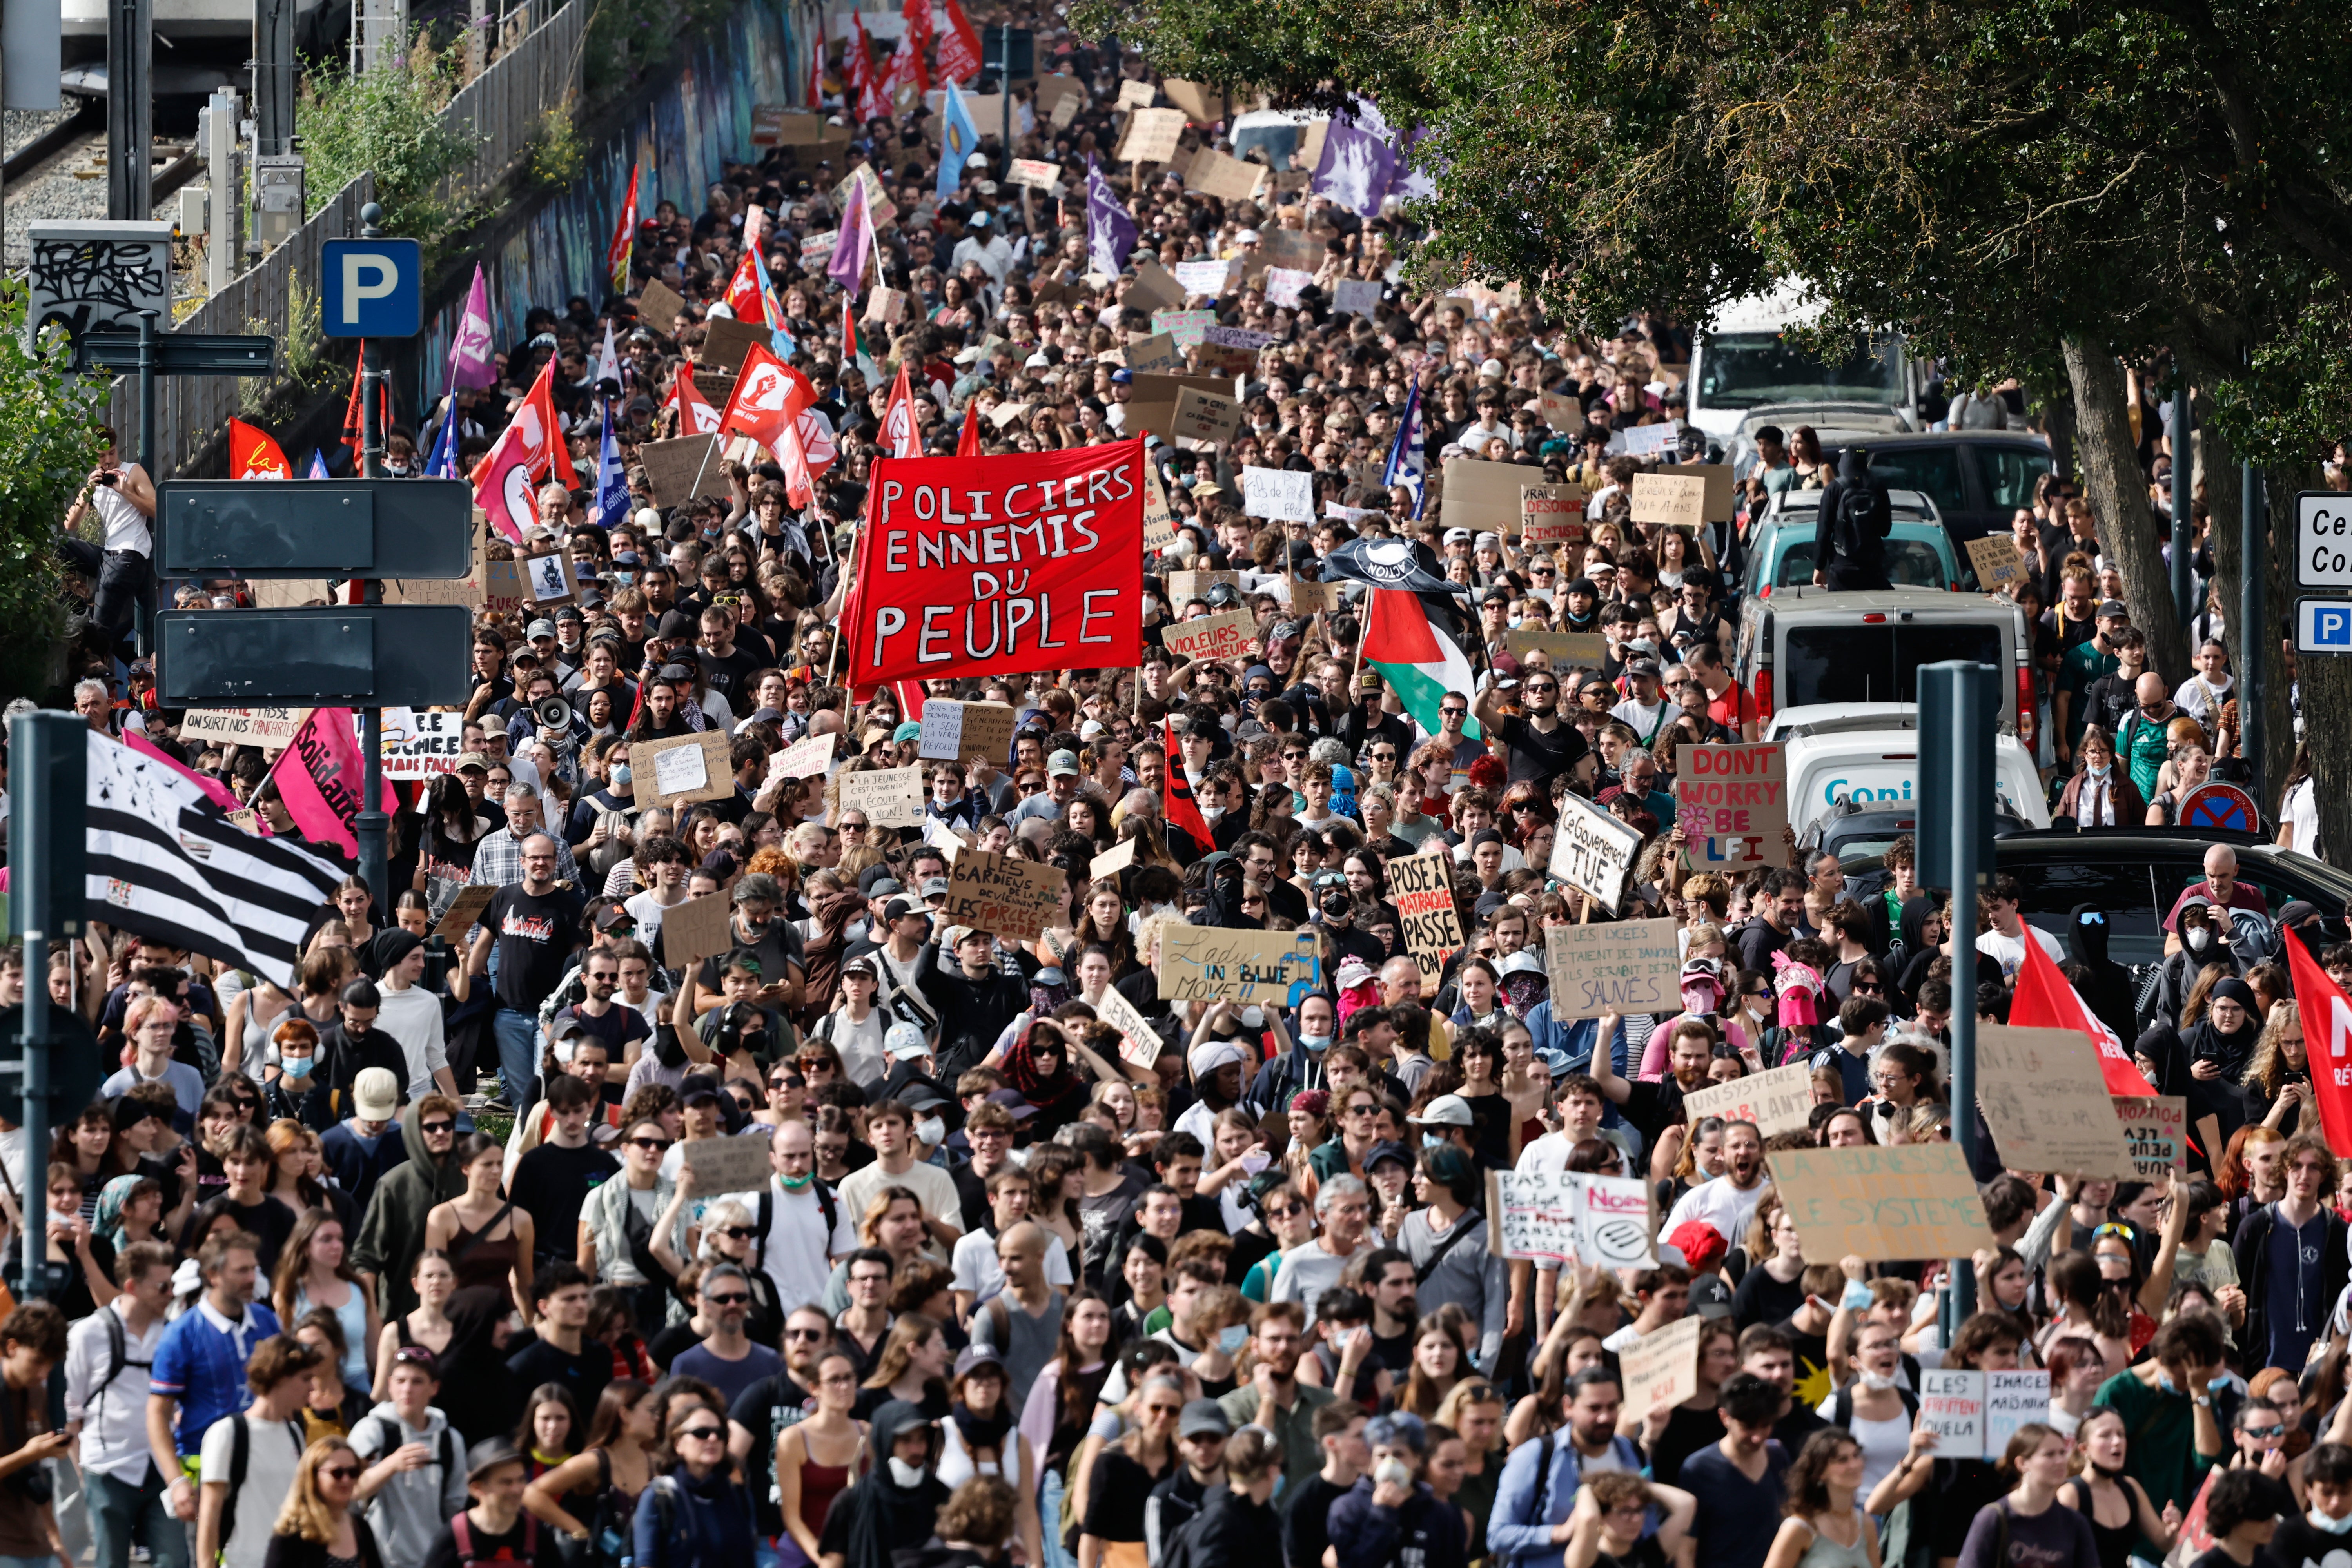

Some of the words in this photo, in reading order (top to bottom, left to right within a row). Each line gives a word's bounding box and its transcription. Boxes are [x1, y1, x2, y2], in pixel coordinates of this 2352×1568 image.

[342, 254, 399, 324] P
[247, 440, 284, 470] la
[882, 464, 1134, 525] POLICIERS
[1270, 479, 1281, 498] de
[1634, 500, 1647, 511] ON
[2313, 509, 2352, 536] Ce
[886, 510, 1099, 572] ENNEMIS
[1367, 561, 1405, 579] ACTION
[2312, 546, 2352, 573] Co
[973, 568, 1030, 602] DU
[1990, 565, 2017, 582] LIBRES
[873, 589, 1120, 667] PEUPLE
[1225, 610, 1250, 624] LES
[2323, 613, 2343, 640] P
[1166, 624, 1240, 655] VIOLEURS
[928, 704, 946, 712] DANS
[187, 715, 202, 728] ON
[202, 715, 229, 731] SORT
[228, 718, 250, 733] NOS
[940, 722, 960, 731] SEUL
[631, 746, 646, 759] Le
[707, 735, 724, 745] des
[656, 750, 693, 764] Laissez
[782, 739, 812, 756] FERMEZ
[381, 758, 419, 773] MAIS
[780, 758, 806, 773] OUVREZ
[1692, 746, 1778, 776] DONT
[633, 769, 656, 782] nos
[872, 772, 912, 784] JEUNESSE
[645, 795, 655, 806] de
[851, 786, 870, 795] C'EST
[867, 793, 898, 806] ÉCOUTE
[1679, 781, 1781, 806] WORRY
[1715, 808, 1751, 833] BE
[1707, 836, 1764, 862] LFI
[954, 862, 1033, 890] GARDIENS
[986, 853, 1025, 877] LES
[1390, 858, 1432, 894] POSE
[1571, 842, 1609, 896] TUE
[978, 888, 1043, 911] DEVIENNENT
[1009, 887, 1020, 896] DE
[1023, 890, 1034, 899] LA
[1397, 889, 1453, 918] MATRAQUE
[947, 895, 982, 918] LES
[979, 902, 1037, 926] FORCES
[957, 916, 976, 926] DE
[1403, 909, 1461, 948] PASSE
[1573, 928, 1596, 942] LES
[1169, 929, 1256, 975] Lady
[1409, 949, 1441, 976] TON
[1557, 948, 1613, 965] ETAIENT
[1617, 947, 1634, 960] DES
[1204, 964, 1225, 980] IN
[1240, 963, 1290, 985] BLUE
[1564, 969, 1583, 981] ILS
[1581, 976, 1660, 1010] SAUVÉS
[1692, 1090, 1720, 1112] UN
[1771, 1152, 1815, 1181] LA
[1822, 1145, 1969, 1175] JEUNESSE
[1503, 1174, 1547, 1189] PAS
[1788, 1198, 1832, 1228] LE
[1839, 1196, 1986, 1228] SYSTEME
[1504, 1223, 1553, 1237] DANS
[1844, 1225, 1959, 1256] CHUTE
[1927, 1374, 1968, 1394] LES
[1992, 1374, 2050, 1389] IMAGES
[1954, 1421, 1973, 1436] LA
